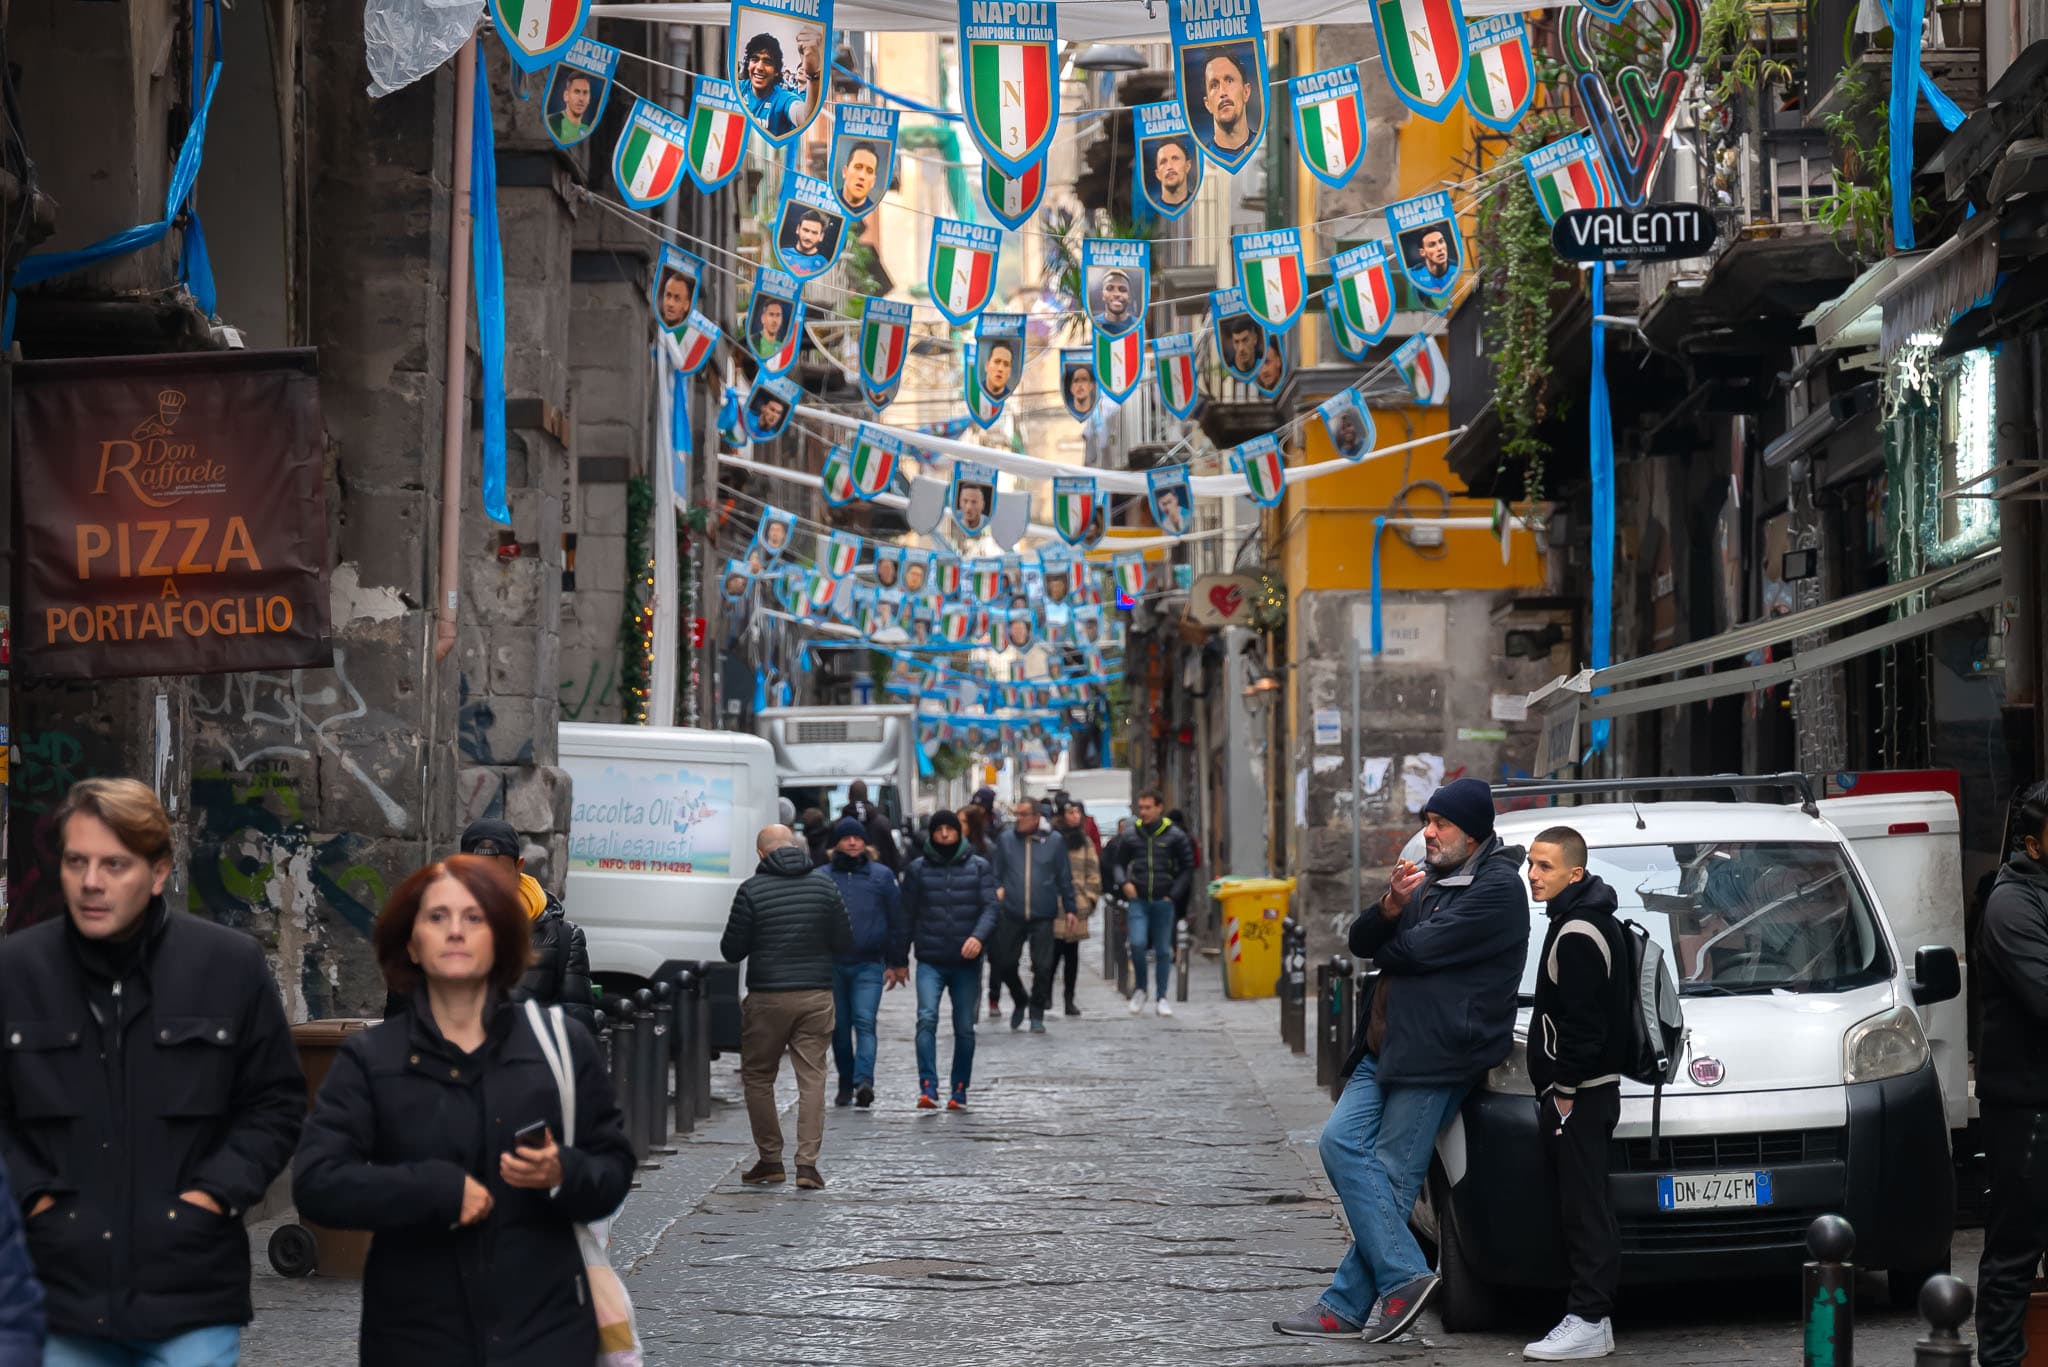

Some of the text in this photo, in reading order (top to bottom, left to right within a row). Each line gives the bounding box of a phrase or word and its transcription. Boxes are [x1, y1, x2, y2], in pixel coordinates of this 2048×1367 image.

[972, 1, 1048, 26] NAPOLI
[1180, 0, 1251, 22] NAPOLI
[527, 19, 539, 38] 3
[966, 26, 1054, 41] CAMPIONE IN ITALIA
[1185, 16, 1248, 40] CAMPIONE
[1469, 13, 1517, 41] APOLI
[571, 38, 613, 63] APOLI
[1410, 26, 1431, 56] N
[565, 51, 607, 74] CAMPIONE
[702, 80, 736, 101] NAPO
[1296, 69, 1353, 94] NAPOLI
[1424, 72, 1436, 92] 3
[1003, 80, 1022, 107] N
[1141, 103, 1180, 122] NAPO
[1498, 98, 1507, 112] 3
[641, 104, 687, 138] NAPO
[842, 107, 893, 126] NAPOLI
[1145, 119, 1186, 134] CAMPIO
[844, 122, 889, 138] CAMPIONE
[1009, 127, 1019, 146] 3
[1529, 137, 1580, 168] NAPOLI
[795, 176, 835, 200] NAP
[795, 190, 841, 214] CAMPION
[1393, 193, 1445, 219] NAPOLI
[1399, 208, 1444, 229] CAMPIONE
[1570, 211, 1700, 247] VALENTI
[941, 221, 997, 242] NAPOLI
[1242, 231, 1294, 250] NAPOLI
[1090, 242, 1144, 256] NAPOLI
[1336, 242, 1380, 270] NAPOLI
[1093, 254, 1140, 267] CAMPIONE
[762, 269, 798, 289] NAPOL
[871, 299, 910, 316] NAPOLI
[1216, 289, 1242, 305] NAP
[147, 438, 196, 465] Don
[90, 440, 227, 508] Raffaele
[75, 516, 263, 580] PIZZA
[160, 578, 180, 600] A
[46, 595, 294, 644] PORTAFOGLIO
[571, 797, 673, 826] accolta Oli
[598, 858, 627, 870] INFO:
[629, 859, 647, 870] 081
[1675, 1179, 1755, 1202] DN 474FM
